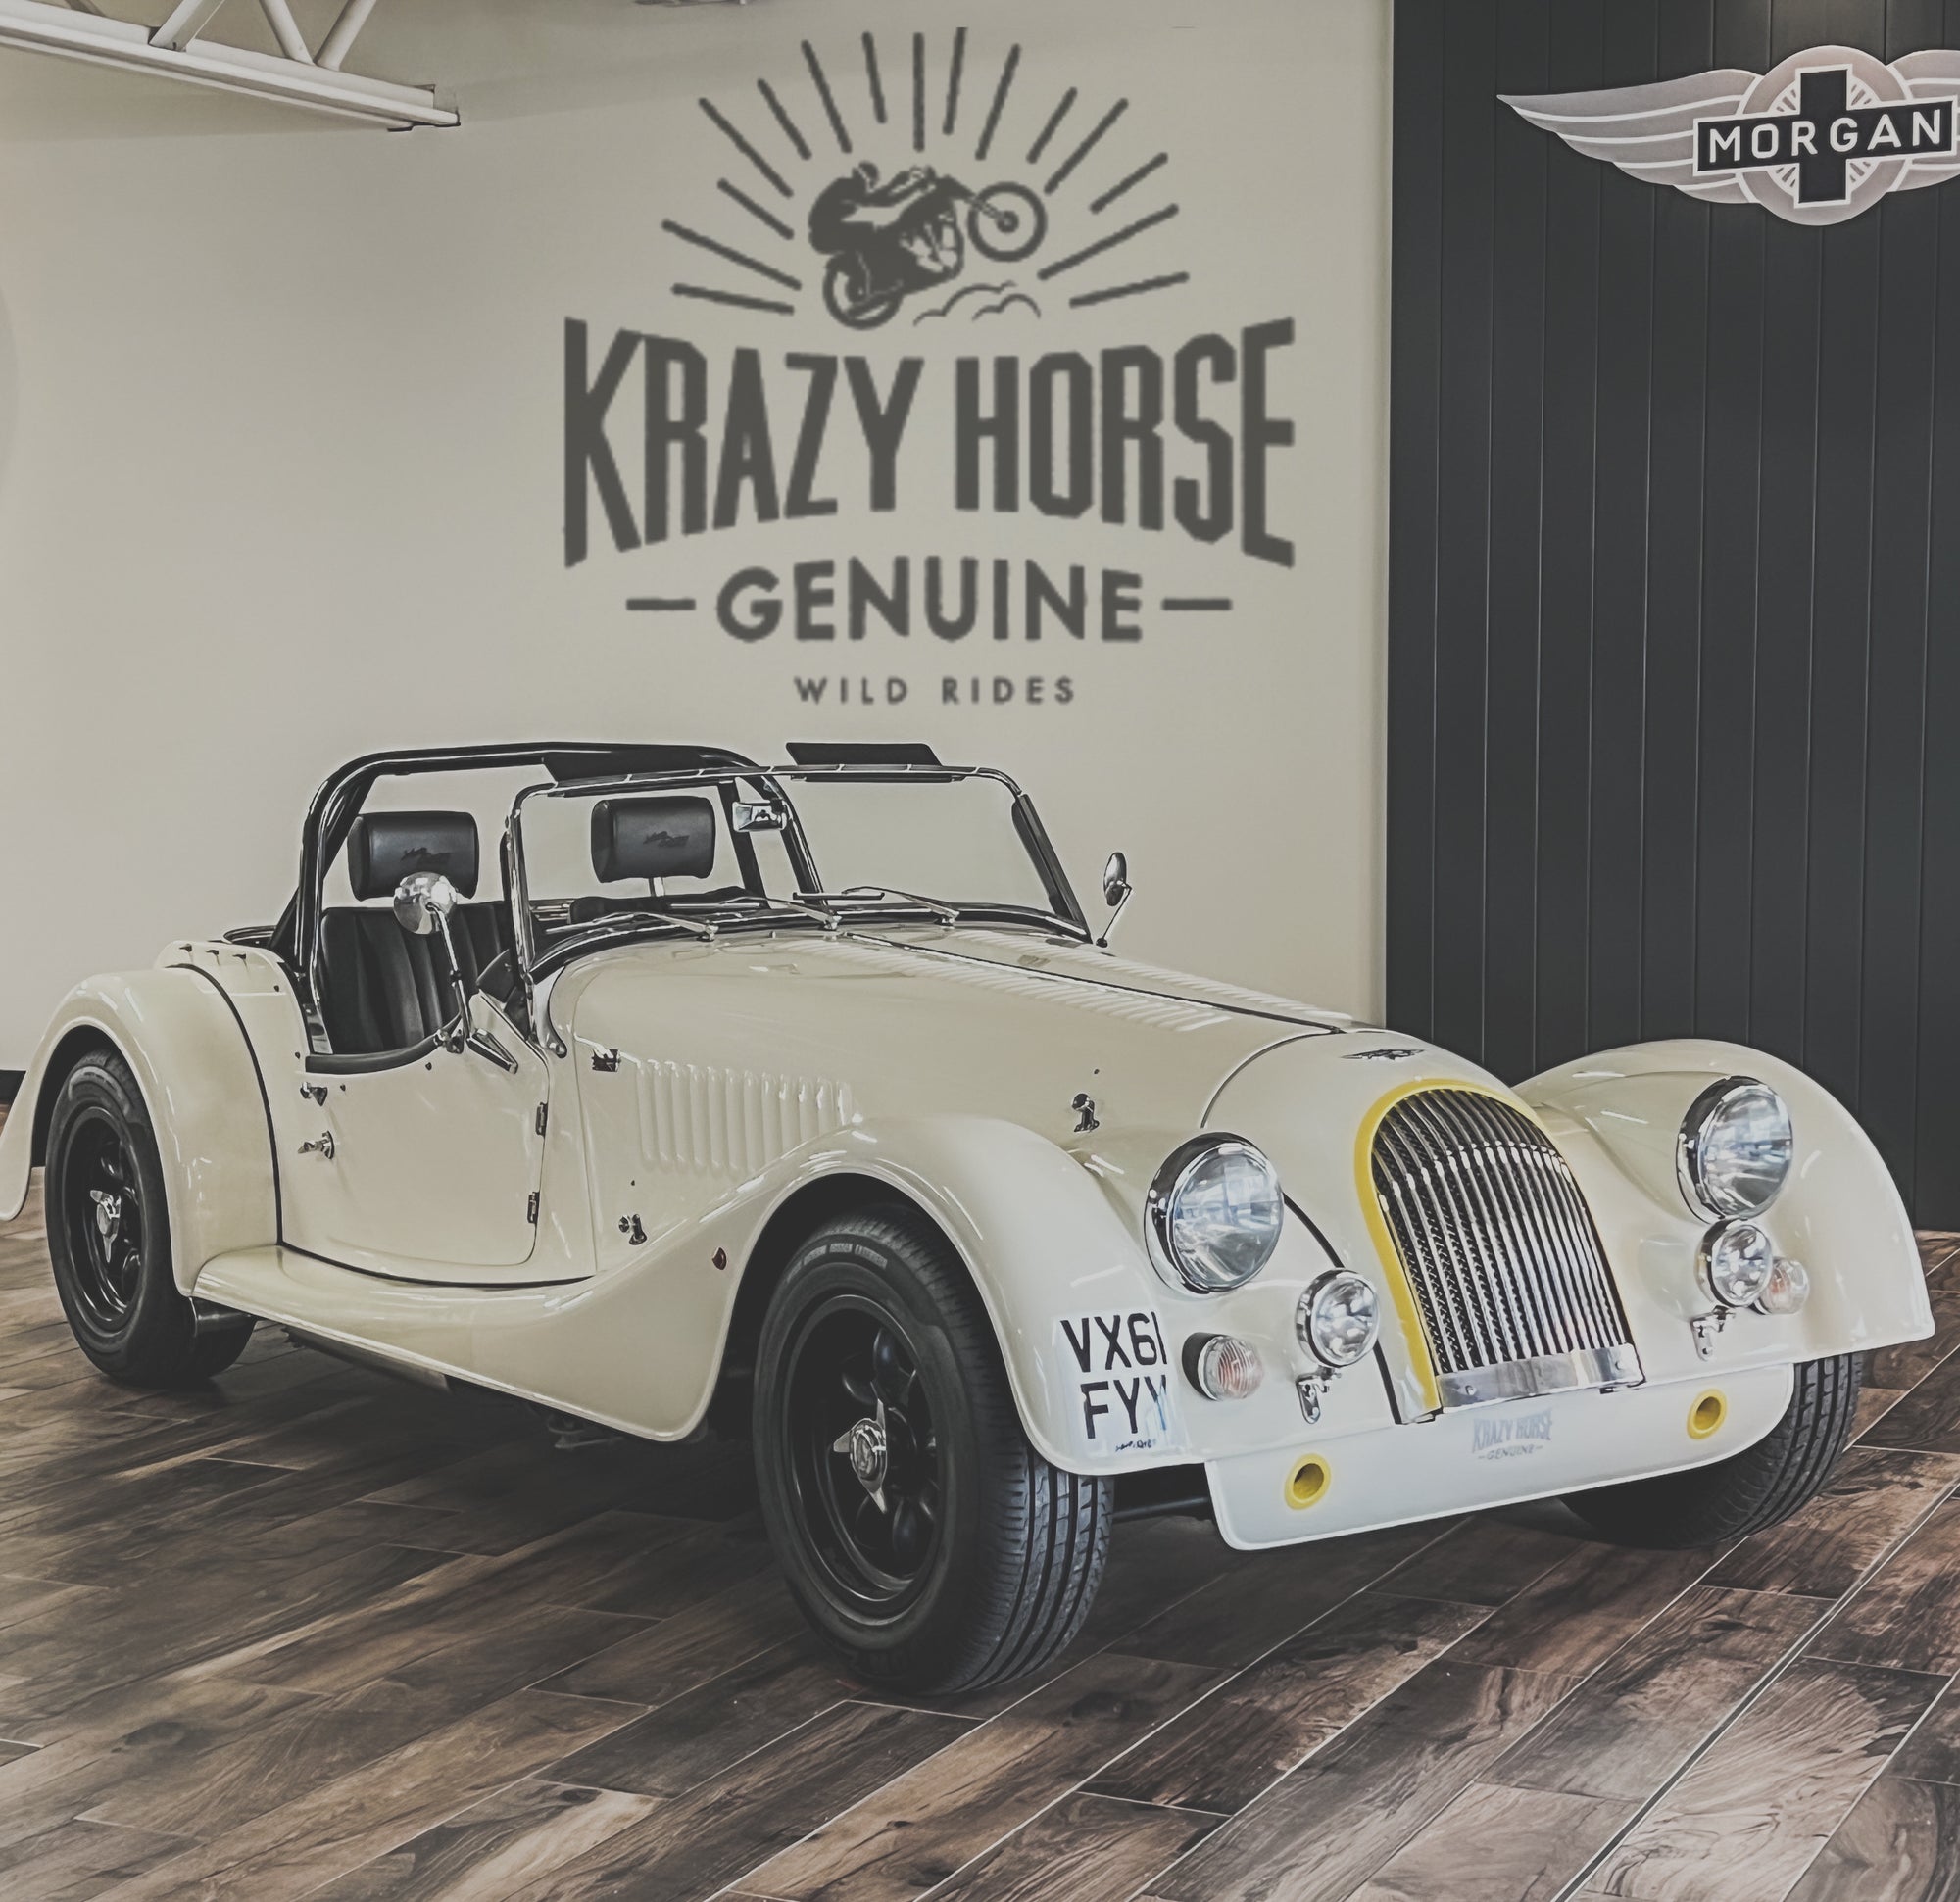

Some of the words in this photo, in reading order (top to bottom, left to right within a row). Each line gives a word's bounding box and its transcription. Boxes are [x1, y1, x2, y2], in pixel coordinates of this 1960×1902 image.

[1708, 109, 1942, 164] MORGAN
[564, 316, 925, 569] KRAZY
[954, 316, 1295, 569] HORSE
[716, 556, 1143, 643] GENUINE
[794, 676, 908, 705] WILD
[941, 676, 1075, 705] RIDES
[1059, 1311, 1168, 1373] VX61
[1080, 1374, 1168, 1439] FYY
